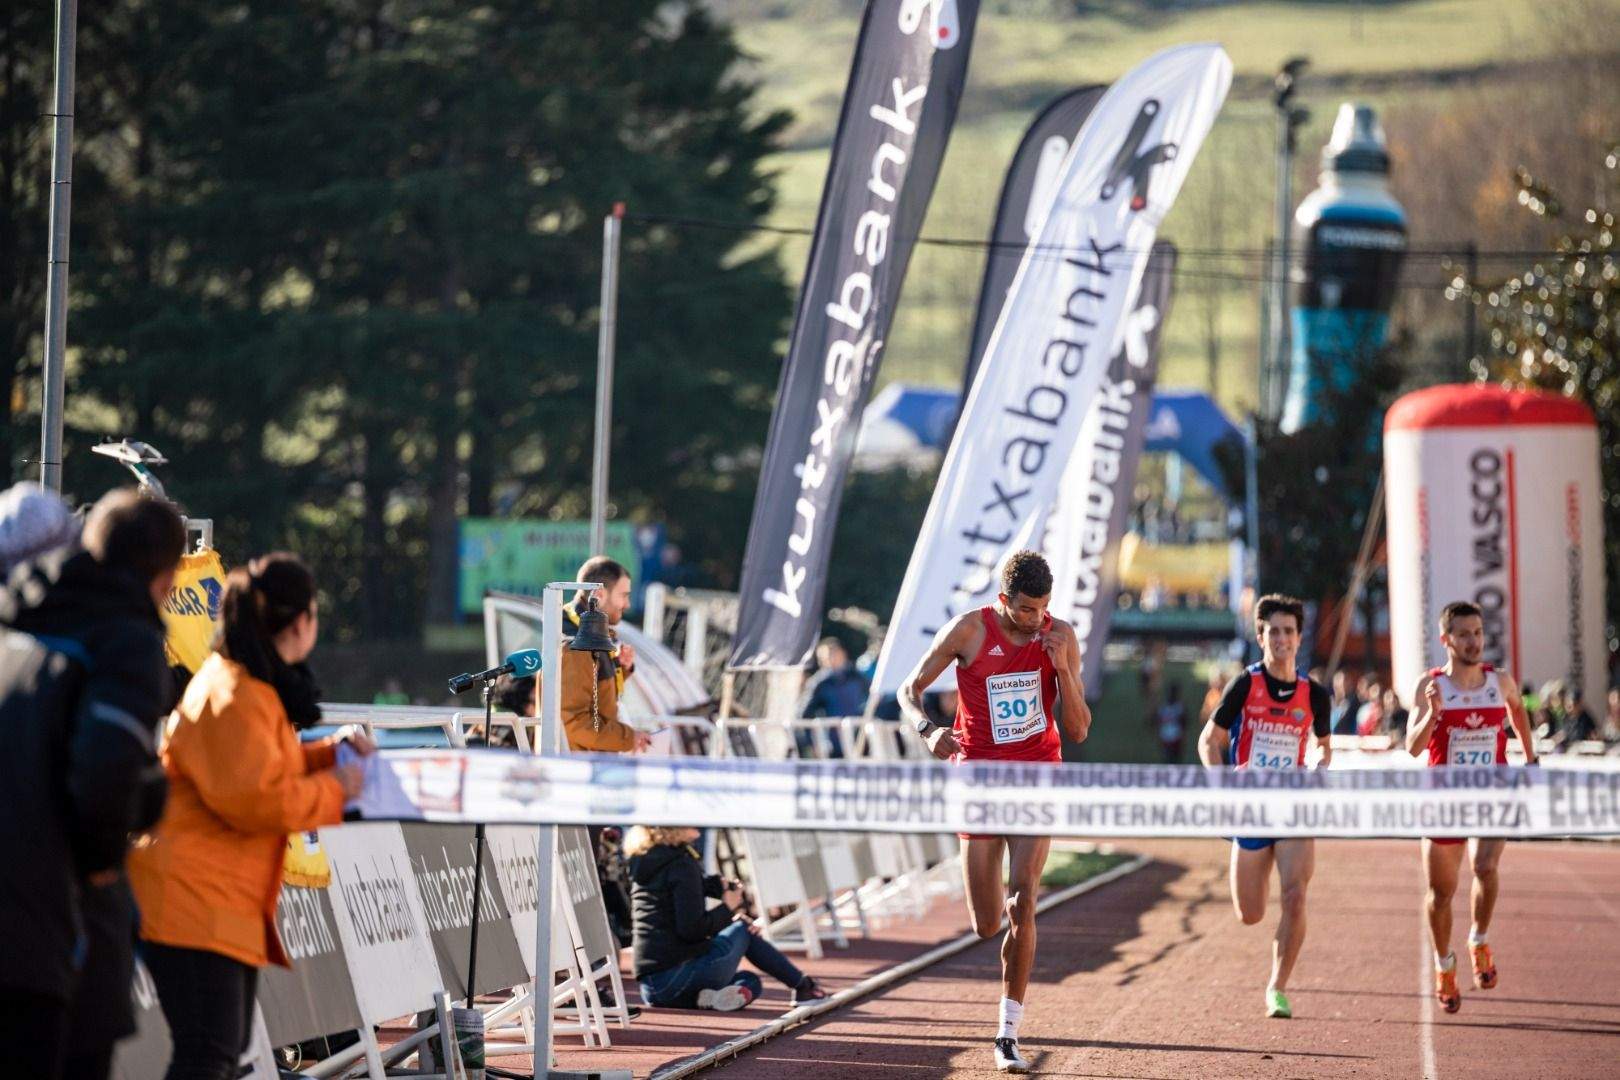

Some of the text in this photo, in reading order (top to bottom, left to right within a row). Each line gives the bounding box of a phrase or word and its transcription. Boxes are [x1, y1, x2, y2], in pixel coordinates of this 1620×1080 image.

[763, 77, 927, 617] kutxabank
[1470, 448, 1504, 580] VASCO
[996, 695, 1038, 719] 301
[1255, 752, 1293, 769] 342
[1455, 751, 1492, 765] 370
[964, 765, 1038, 787] JUAN
[795, 762, 948, 823] ELGOIBAR
[964, 801, 1533, 829] CROSS INTERNACINAL JUAN MUGUERZA
